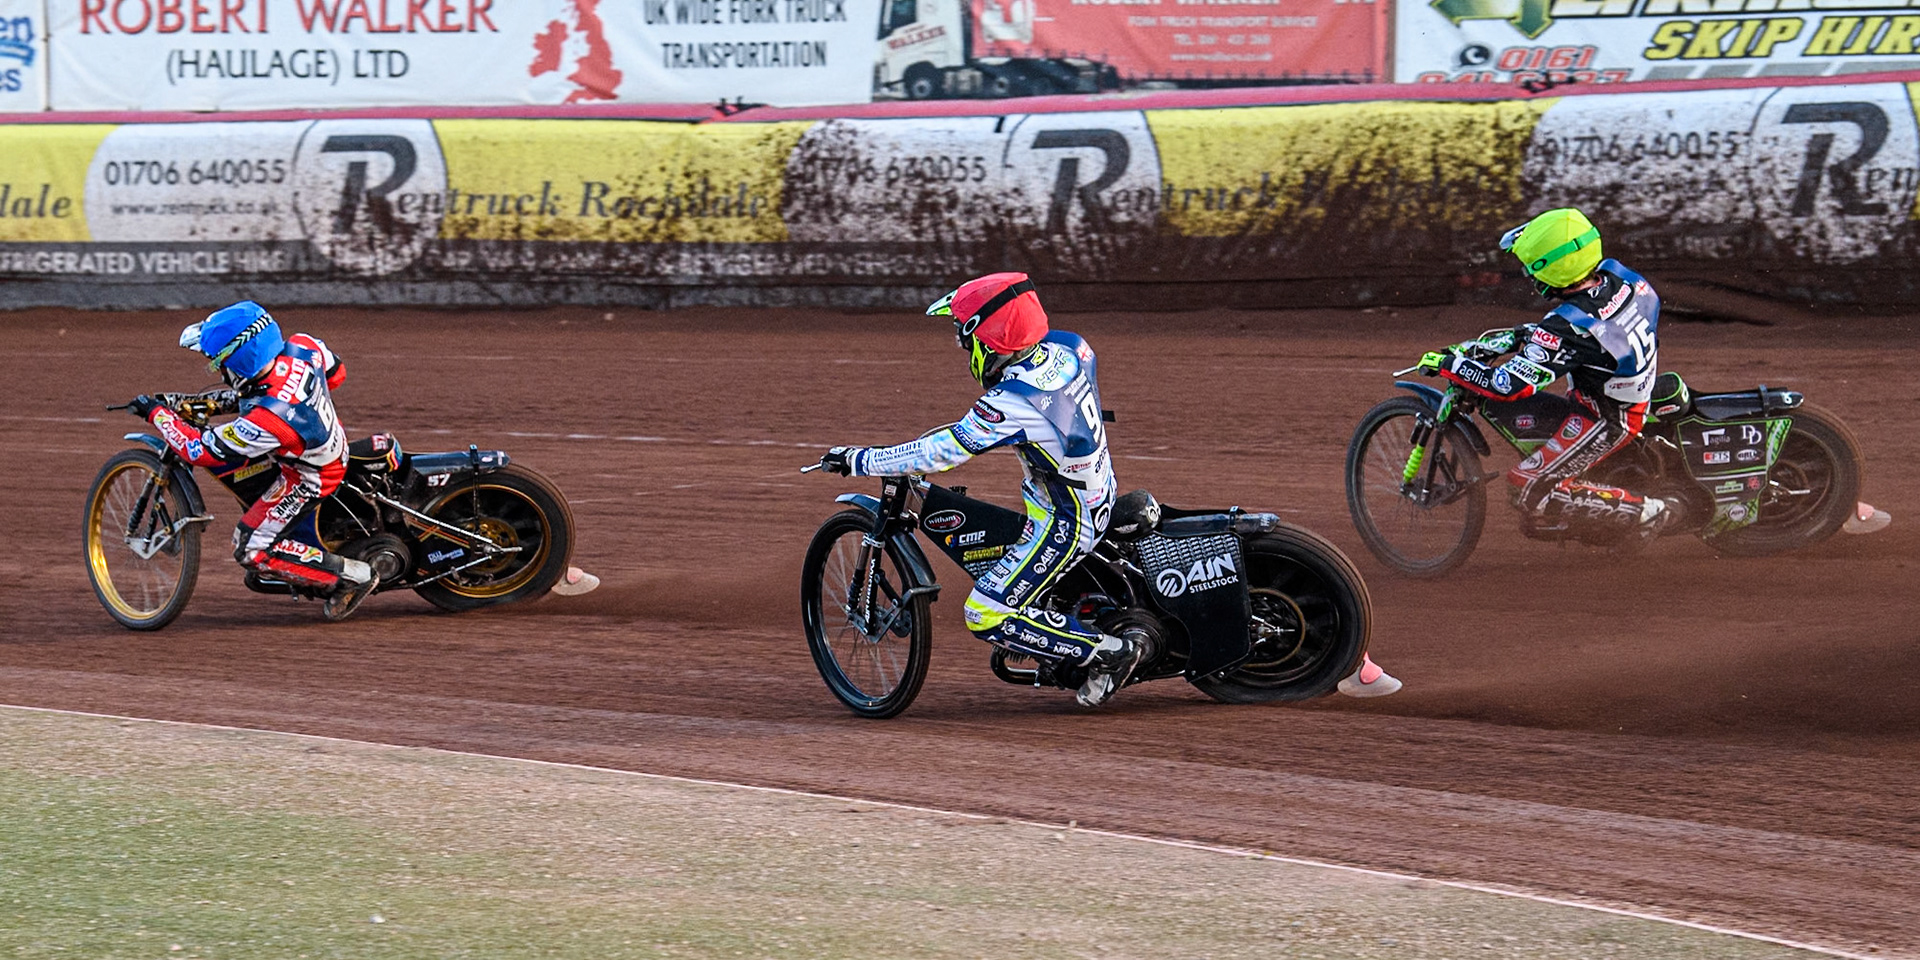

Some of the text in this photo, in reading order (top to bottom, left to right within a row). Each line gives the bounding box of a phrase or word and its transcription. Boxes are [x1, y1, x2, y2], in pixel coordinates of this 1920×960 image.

[643, 0, 847, 25] UK WIDE FORK TRUCK
[1642, 17, 1804, 60] SKIP
[167, 49, 409, 84] (HAULAGE) LTD
[661, 41, 827, 69] TRANSPORTATION
[1497, 45, 1597, 70] 0161
[104, 159, 285, 185] 01706 640055
[138, 252, 230, 274] VEHICLE
[1533, 330, 1560, 346] NGK
[1627, 317, 1656, 372] 15
[1458, 365, 1489, 388] agilia
[1081, 391, 1101, 443] 9
[427, 473, 451, 487] 57
[928, 515, 956, 525] witham
[959, 531, 986, 543] CMP
[1187, 553, 1236, 585] AJN
[1189, 574, 1239, 594] STEELSTOCK
